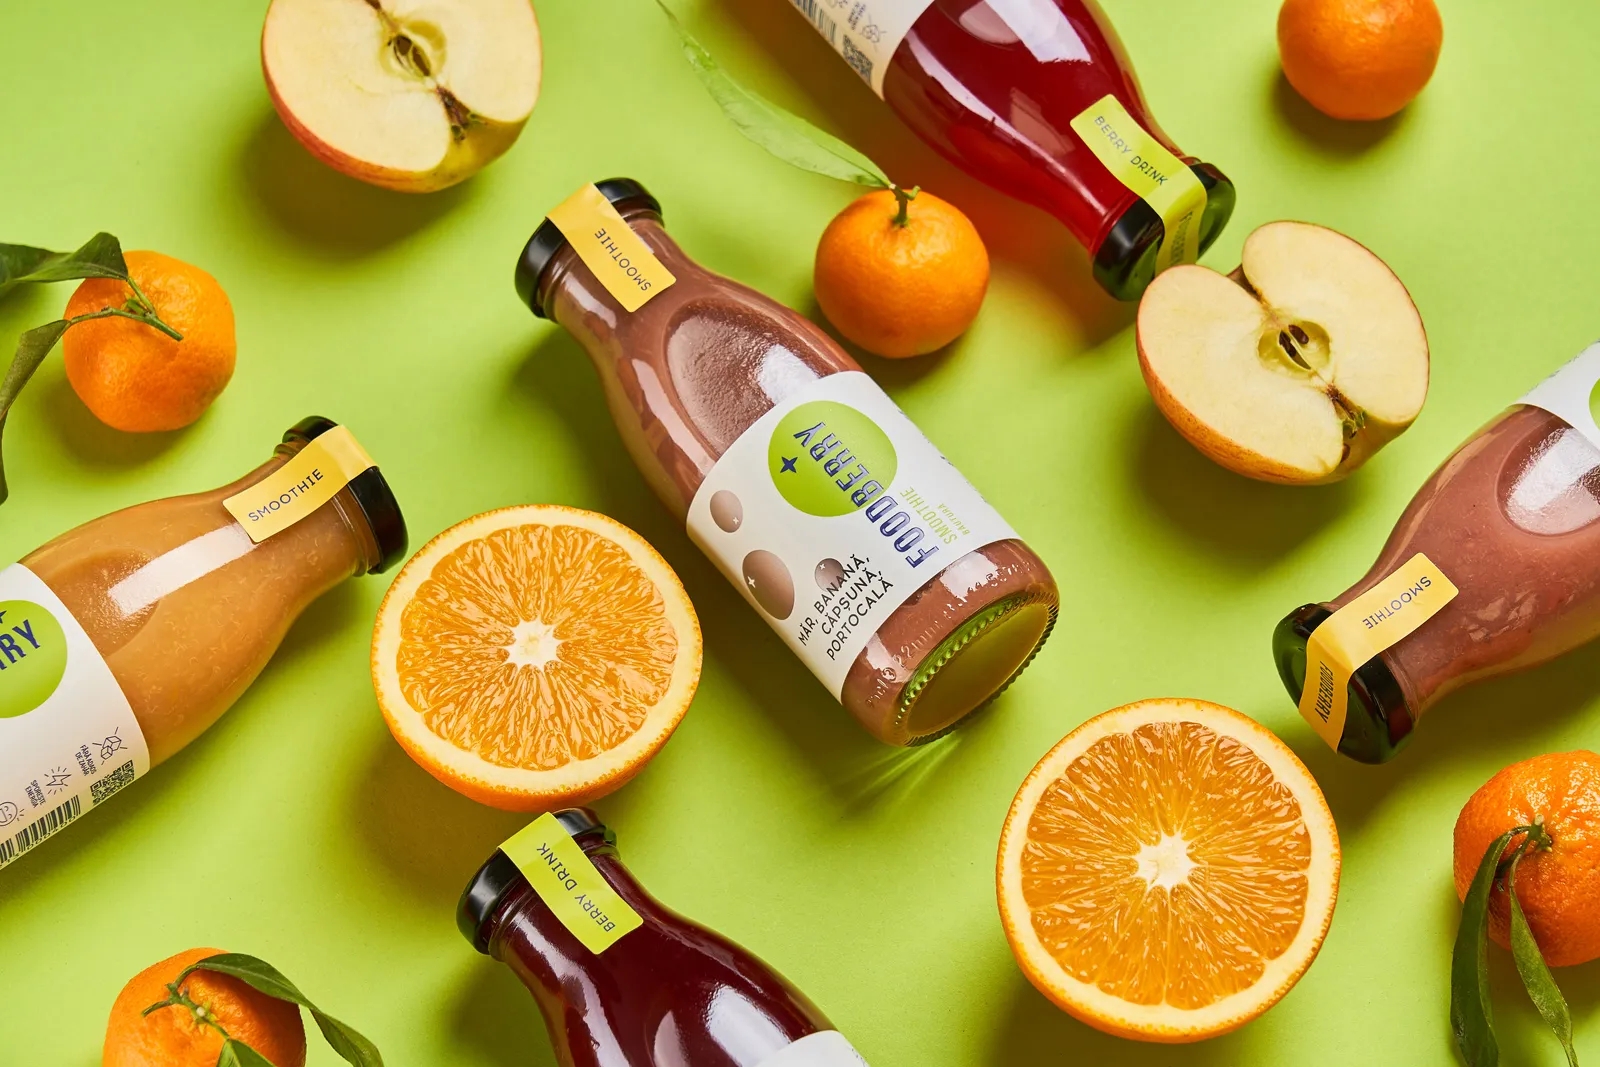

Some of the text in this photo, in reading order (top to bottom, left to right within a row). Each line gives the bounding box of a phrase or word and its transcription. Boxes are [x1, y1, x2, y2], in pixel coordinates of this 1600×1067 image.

[1094, 115, 1169, 186] BERRY DRINK
[594, 227, 652, 291] SMOOTHIE
[248, 468, 324, 522] SMOOTHIE
[793, 421, 939, 569] FOODBERRY
[900, 486, 958, 545] SMOOTHIE
[798, 553, 870, 647] MĂR, BANANĂ,
[821, 567, 882, 635] CĂPȘUNĂ,
[826, 576, 894, 661] PORTOCALĂ
[1362, 576, 1432, 629] SMOOTHIE
[0, 619, 41, 671] RY
[1314, 660, 1334, 724] FOODBERRY
[536, 842, 616, 933] BERRY DRINK
